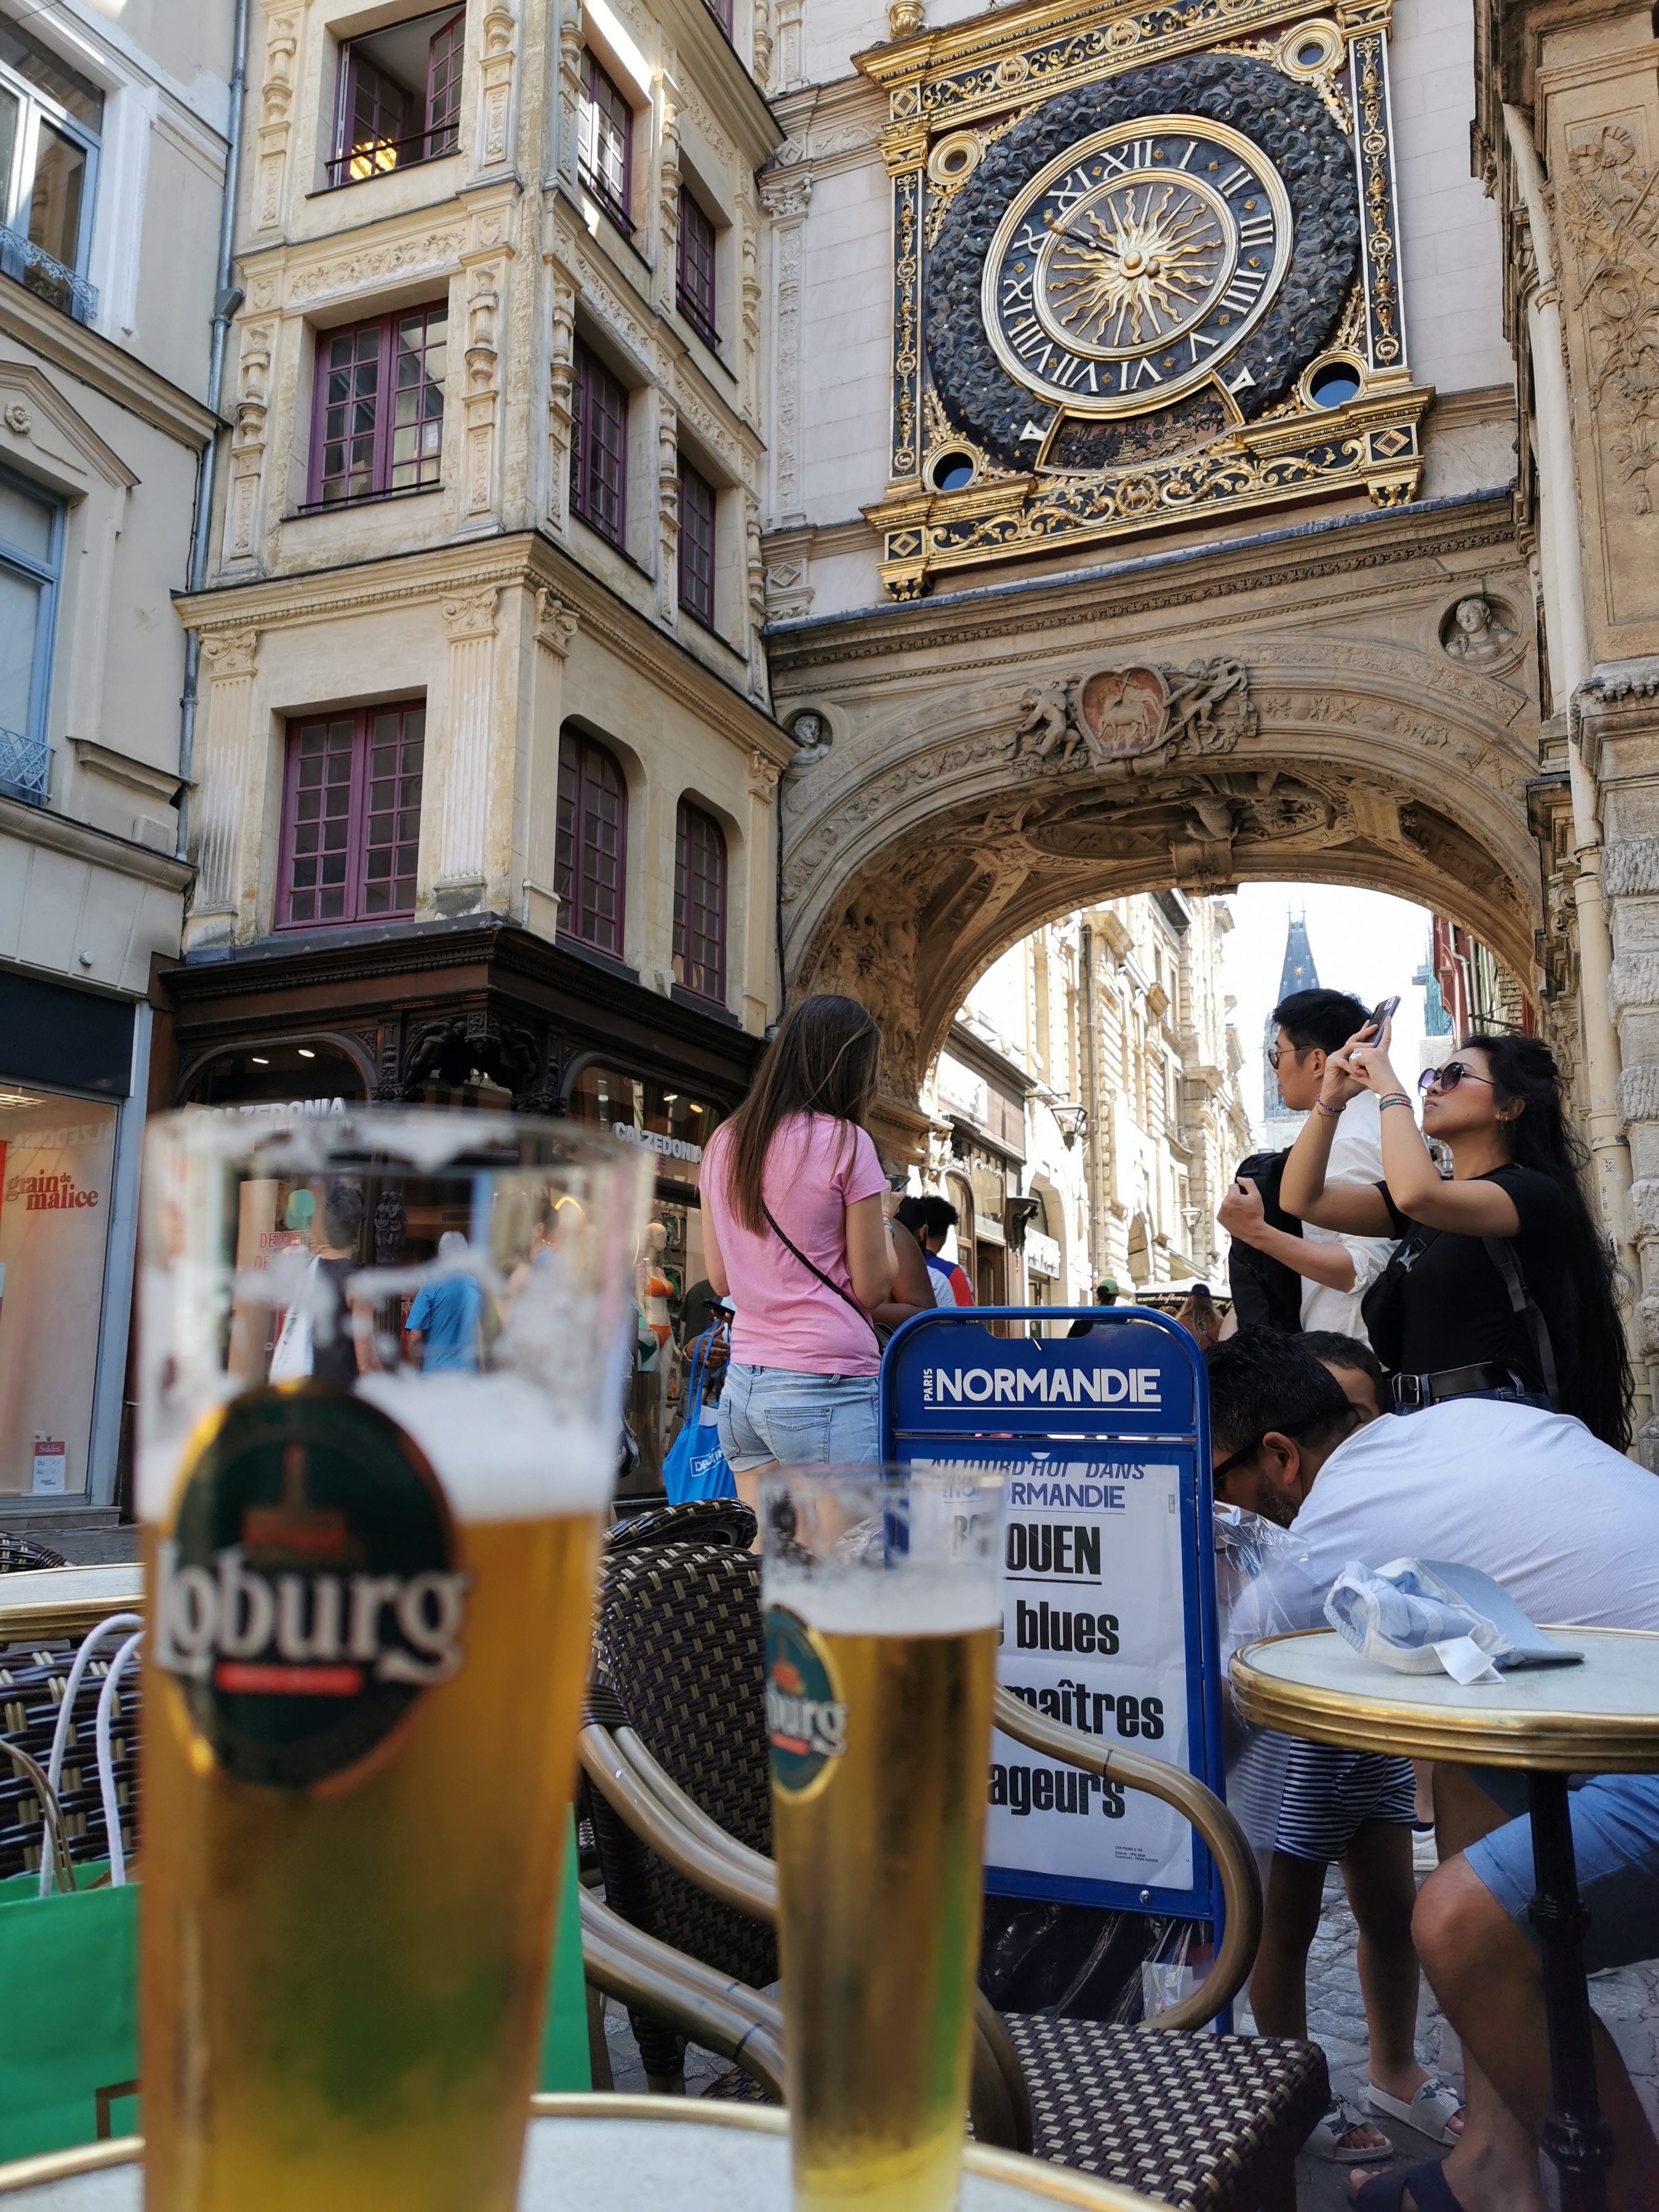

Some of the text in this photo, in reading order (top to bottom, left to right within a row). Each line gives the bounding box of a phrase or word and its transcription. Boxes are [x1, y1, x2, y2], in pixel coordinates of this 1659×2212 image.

[1099, 139, 1155, 179] XII
[1177, 141, 1198, 170] I
[1045, 166, 1094, 213] XI
[1217, 166, 1253, 198] II
[1012, 222, 1050, 254] X
[1240, 212, 1273, 249] III
[1003, 273, 1033, 318] IX
[1218, 268, 1267, 315] IIII
[1008, 314, 1053, 374] VIII
[1190, 332, 1221, 363] V
[1050, 354, 1099, 392] VII
[1119, 357, 1163, 391] VI
[612, 1122, 702, 1163] CALZEDONIA
[5, 1169, 72, 1201] grain de
[25, 1184, 98, 1210] malice
[923, 1368, 1161, 1403] PARIS NORMANDIE
[1085, 1462, 1146, 1480] DANS
[1016, 1600, 1120, 1655] blues
